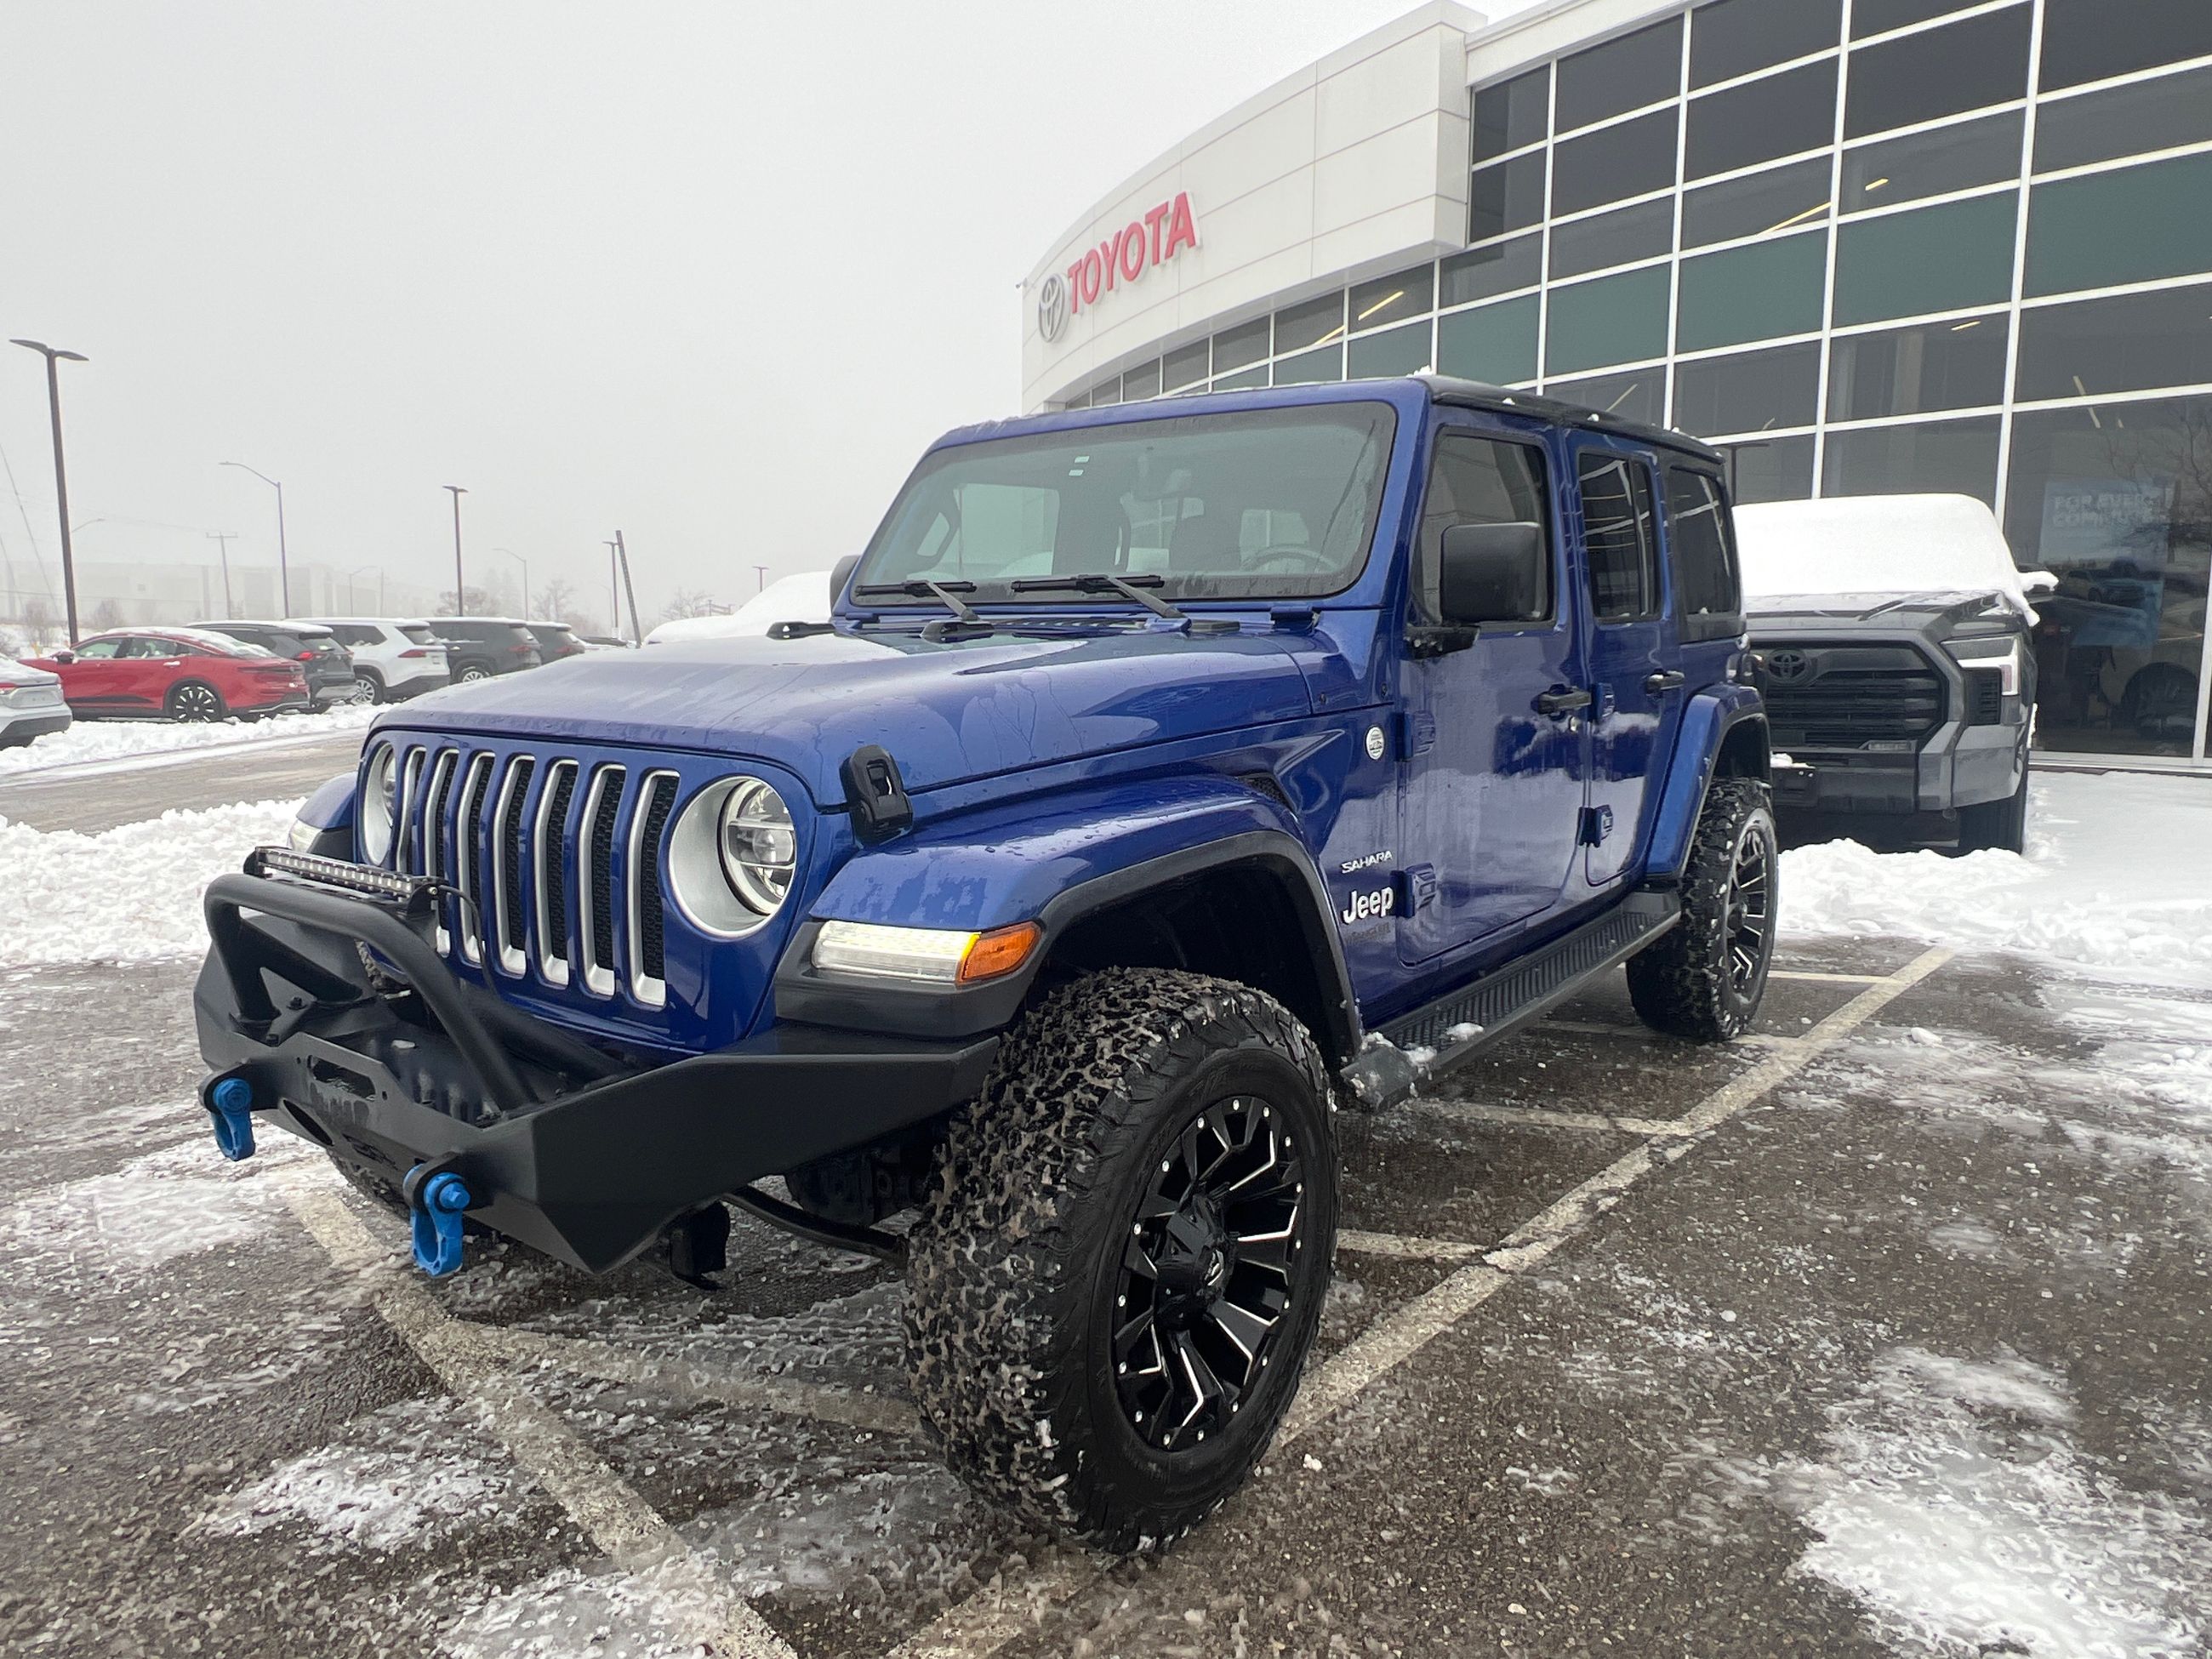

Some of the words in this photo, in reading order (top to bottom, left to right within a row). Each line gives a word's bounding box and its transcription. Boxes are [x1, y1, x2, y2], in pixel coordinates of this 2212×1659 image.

[1068, 191, 1196, 314] TOYOTA
[1341, 850, 1393, 874] SAHARA
[1343, 887, 1394, 924] Jeep
